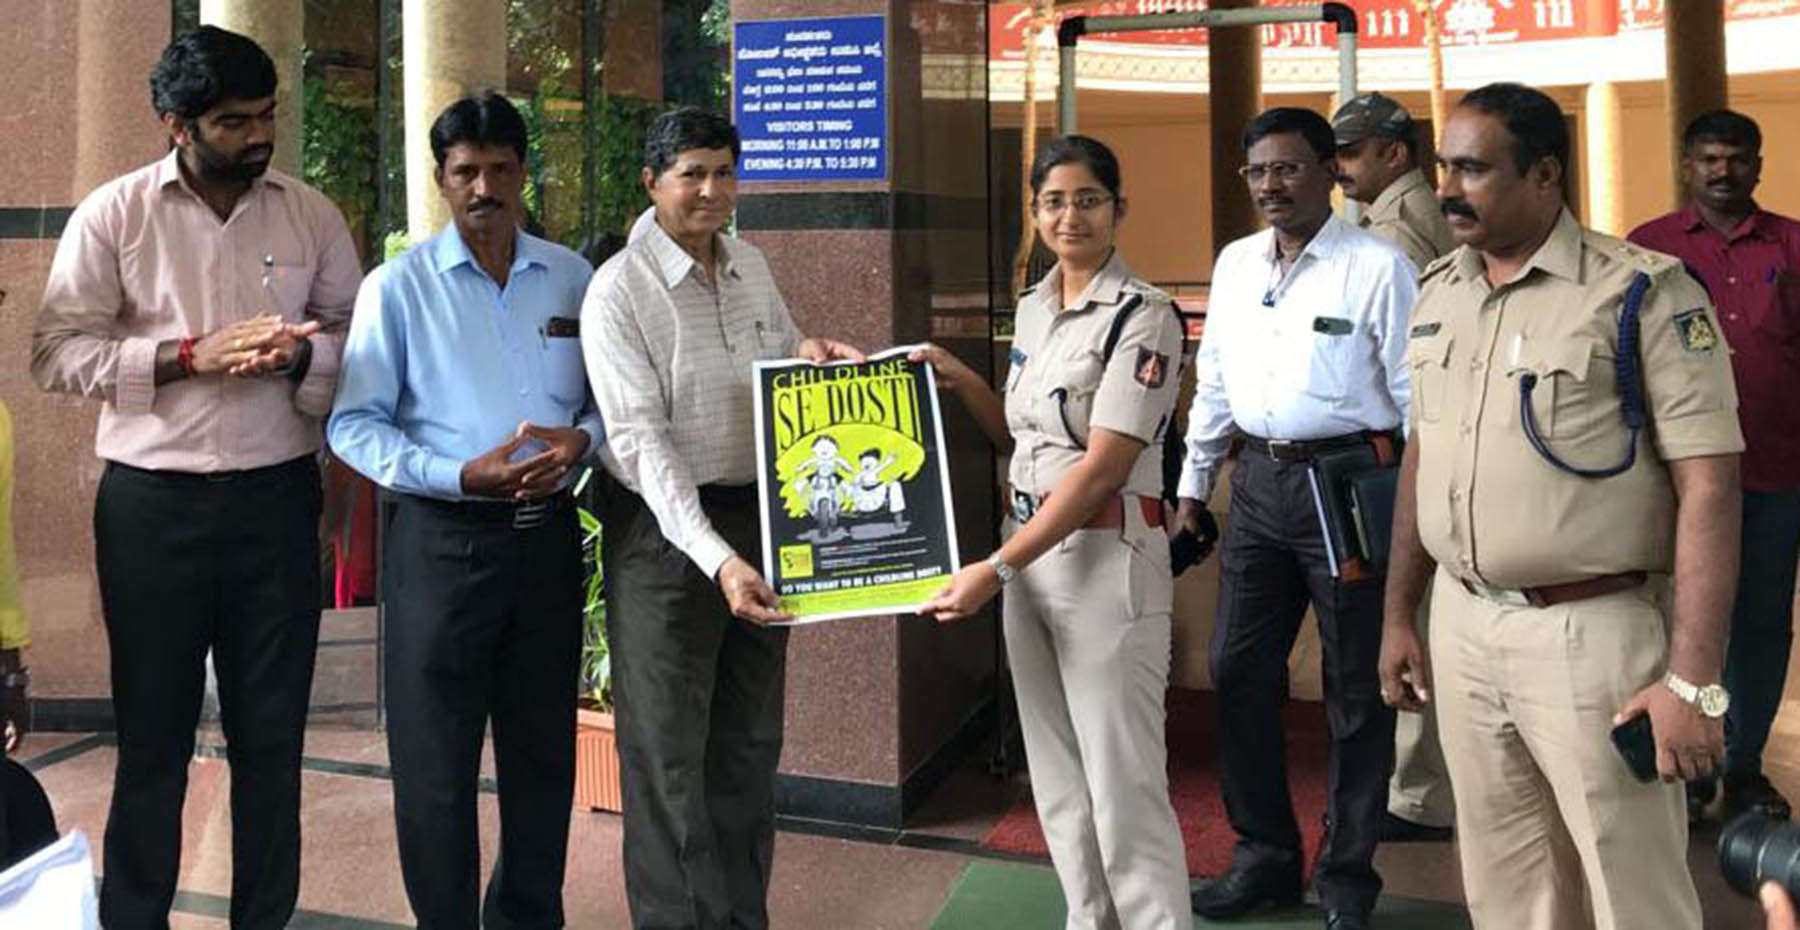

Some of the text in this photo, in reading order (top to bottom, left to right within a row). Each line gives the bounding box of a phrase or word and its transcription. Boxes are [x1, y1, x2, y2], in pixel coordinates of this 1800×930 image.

[766, 120, 853, 132] VISITORS TIMING
[741, 139, 785, 151] MORNING
[744, 158, 784, 170] EVENING
[825, 157, 839, 169] TO
[773, 359, 908, 389] CHILDLINE
[777, 376, 922, 450] SE DOSTI
[795, 582, 813, 593] YOU
[814, 580, 839, 591] WANT
[854, 577, 864, 587] BE
[866, 576, 872, 585] A
